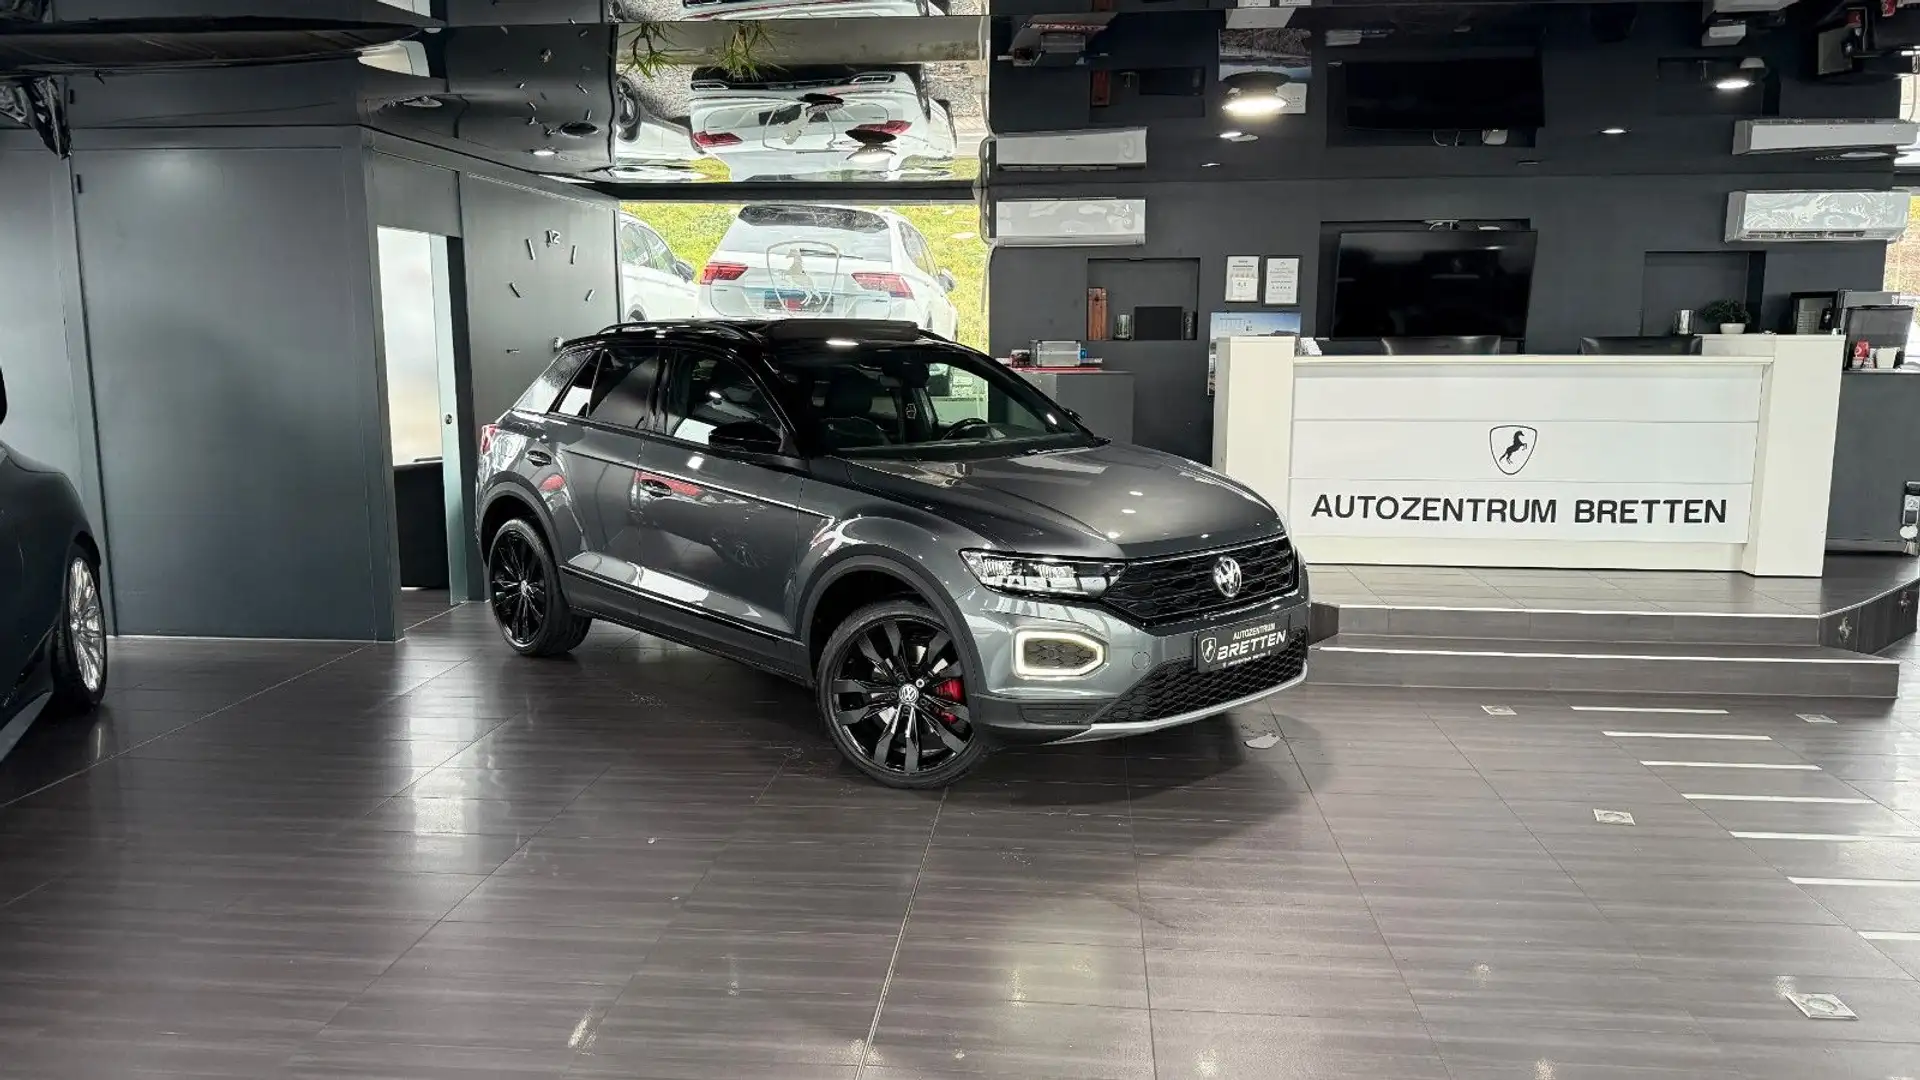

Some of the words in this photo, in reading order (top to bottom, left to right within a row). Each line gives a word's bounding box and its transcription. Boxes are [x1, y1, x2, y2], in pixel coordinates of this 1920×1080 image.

[1311, 494, 1557, 524] AUTOZENTRUM
[1574, 499, 1727, 525] BRETTEN
[1217, 629, 1287, 660] BRETTEN
[1232, 622, 1276, 641] AUTOZENTRUM
